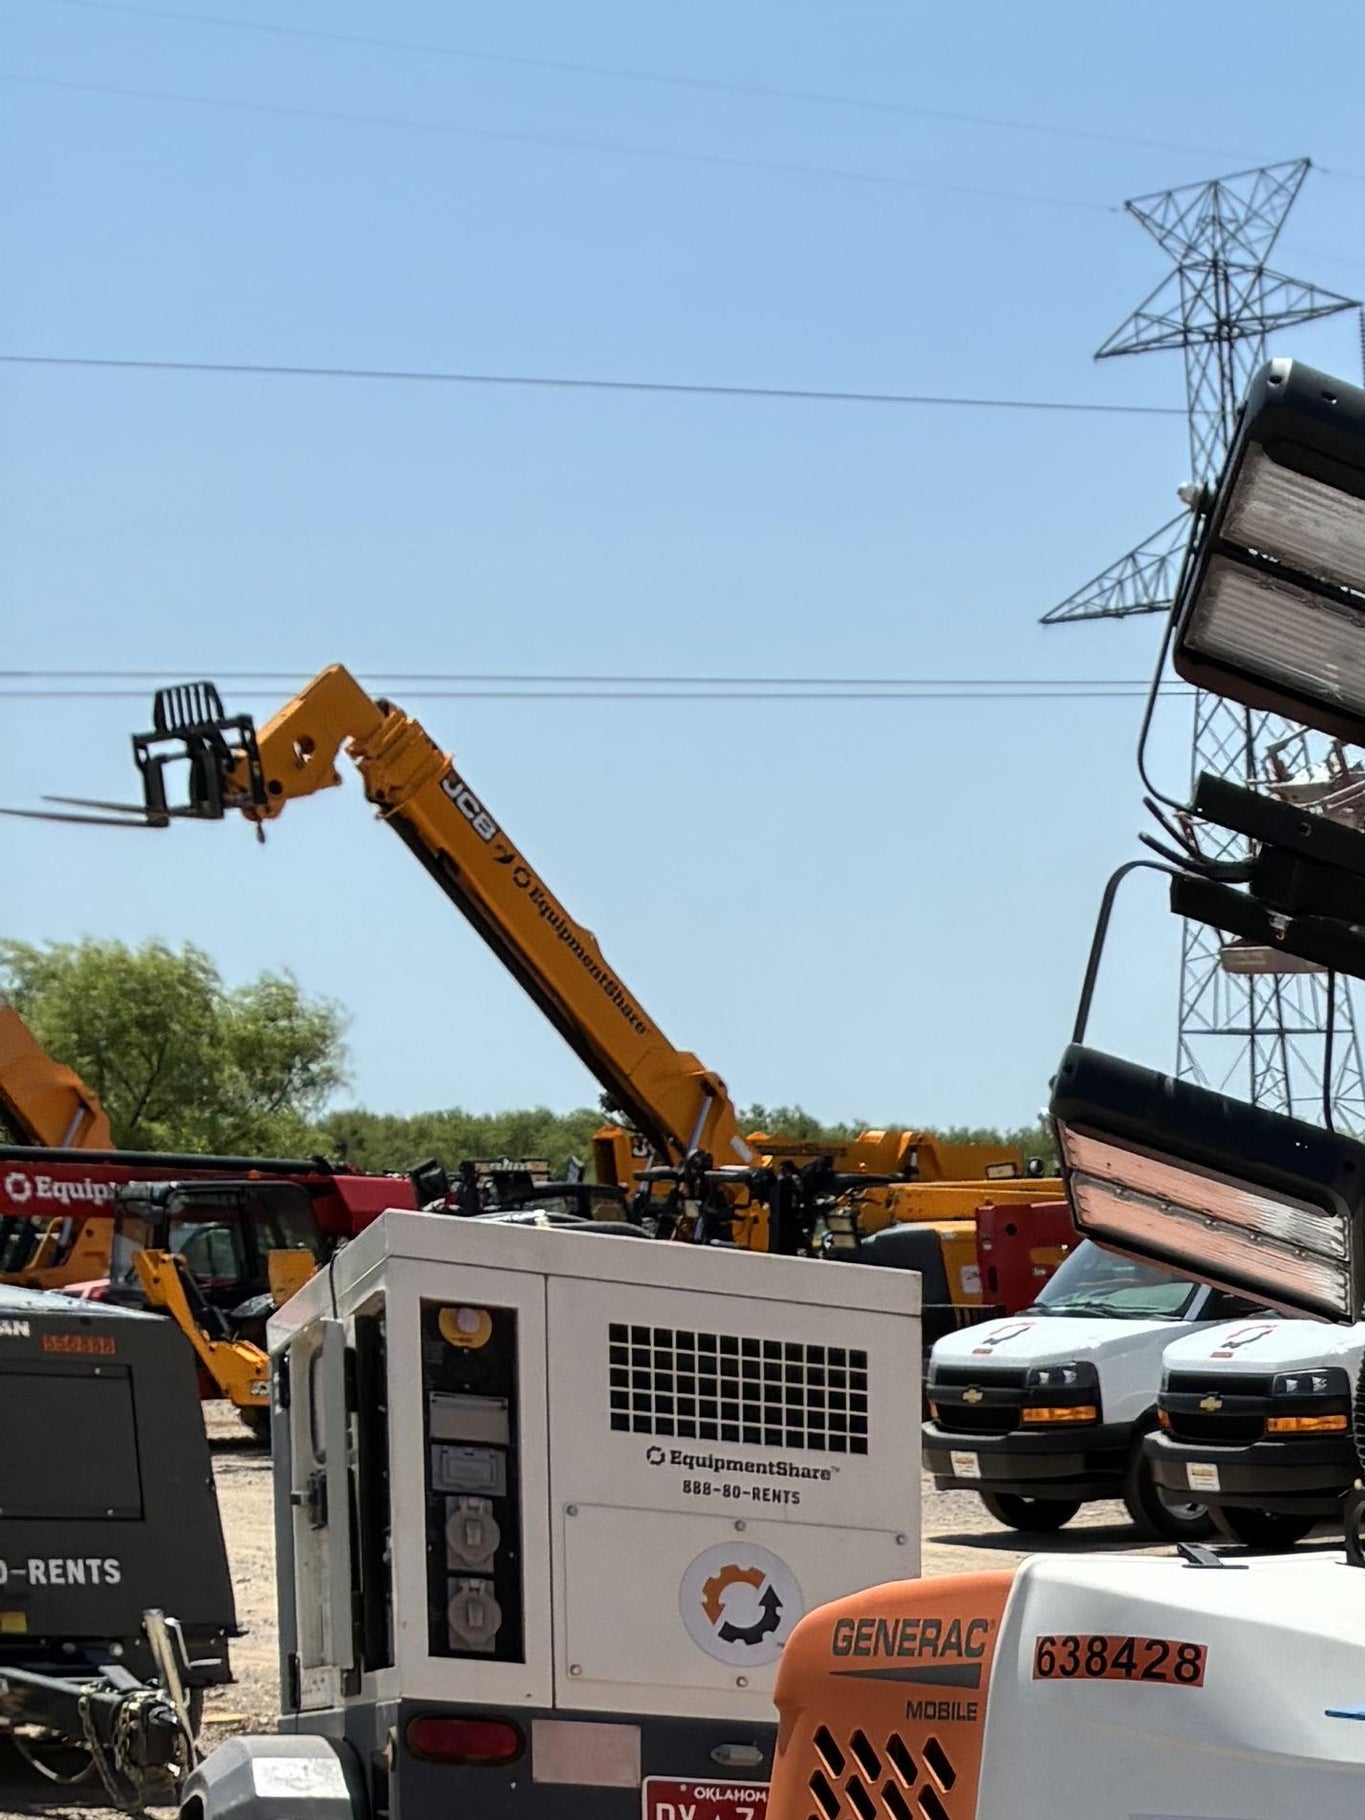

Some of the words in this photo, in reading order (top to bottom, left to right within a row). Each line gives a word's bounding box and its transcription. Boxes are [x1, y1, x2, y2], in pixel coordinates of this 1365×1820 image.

[440, 778, 497, 843] JCB
[528, 886, 649, 1036] EquipmentShare
[669, 1449, 832, 1482] EquipmentShare
[683, 1480, 801, 1506] 888-80-RENTS
[831, 1617, 990, 1659] GENERAC
[1036, 1635, 1203, 1685] 638428
[905, 1700, 978, 1722] MOBILE
[694, 1786, 768, 1803] OKLAHOM
